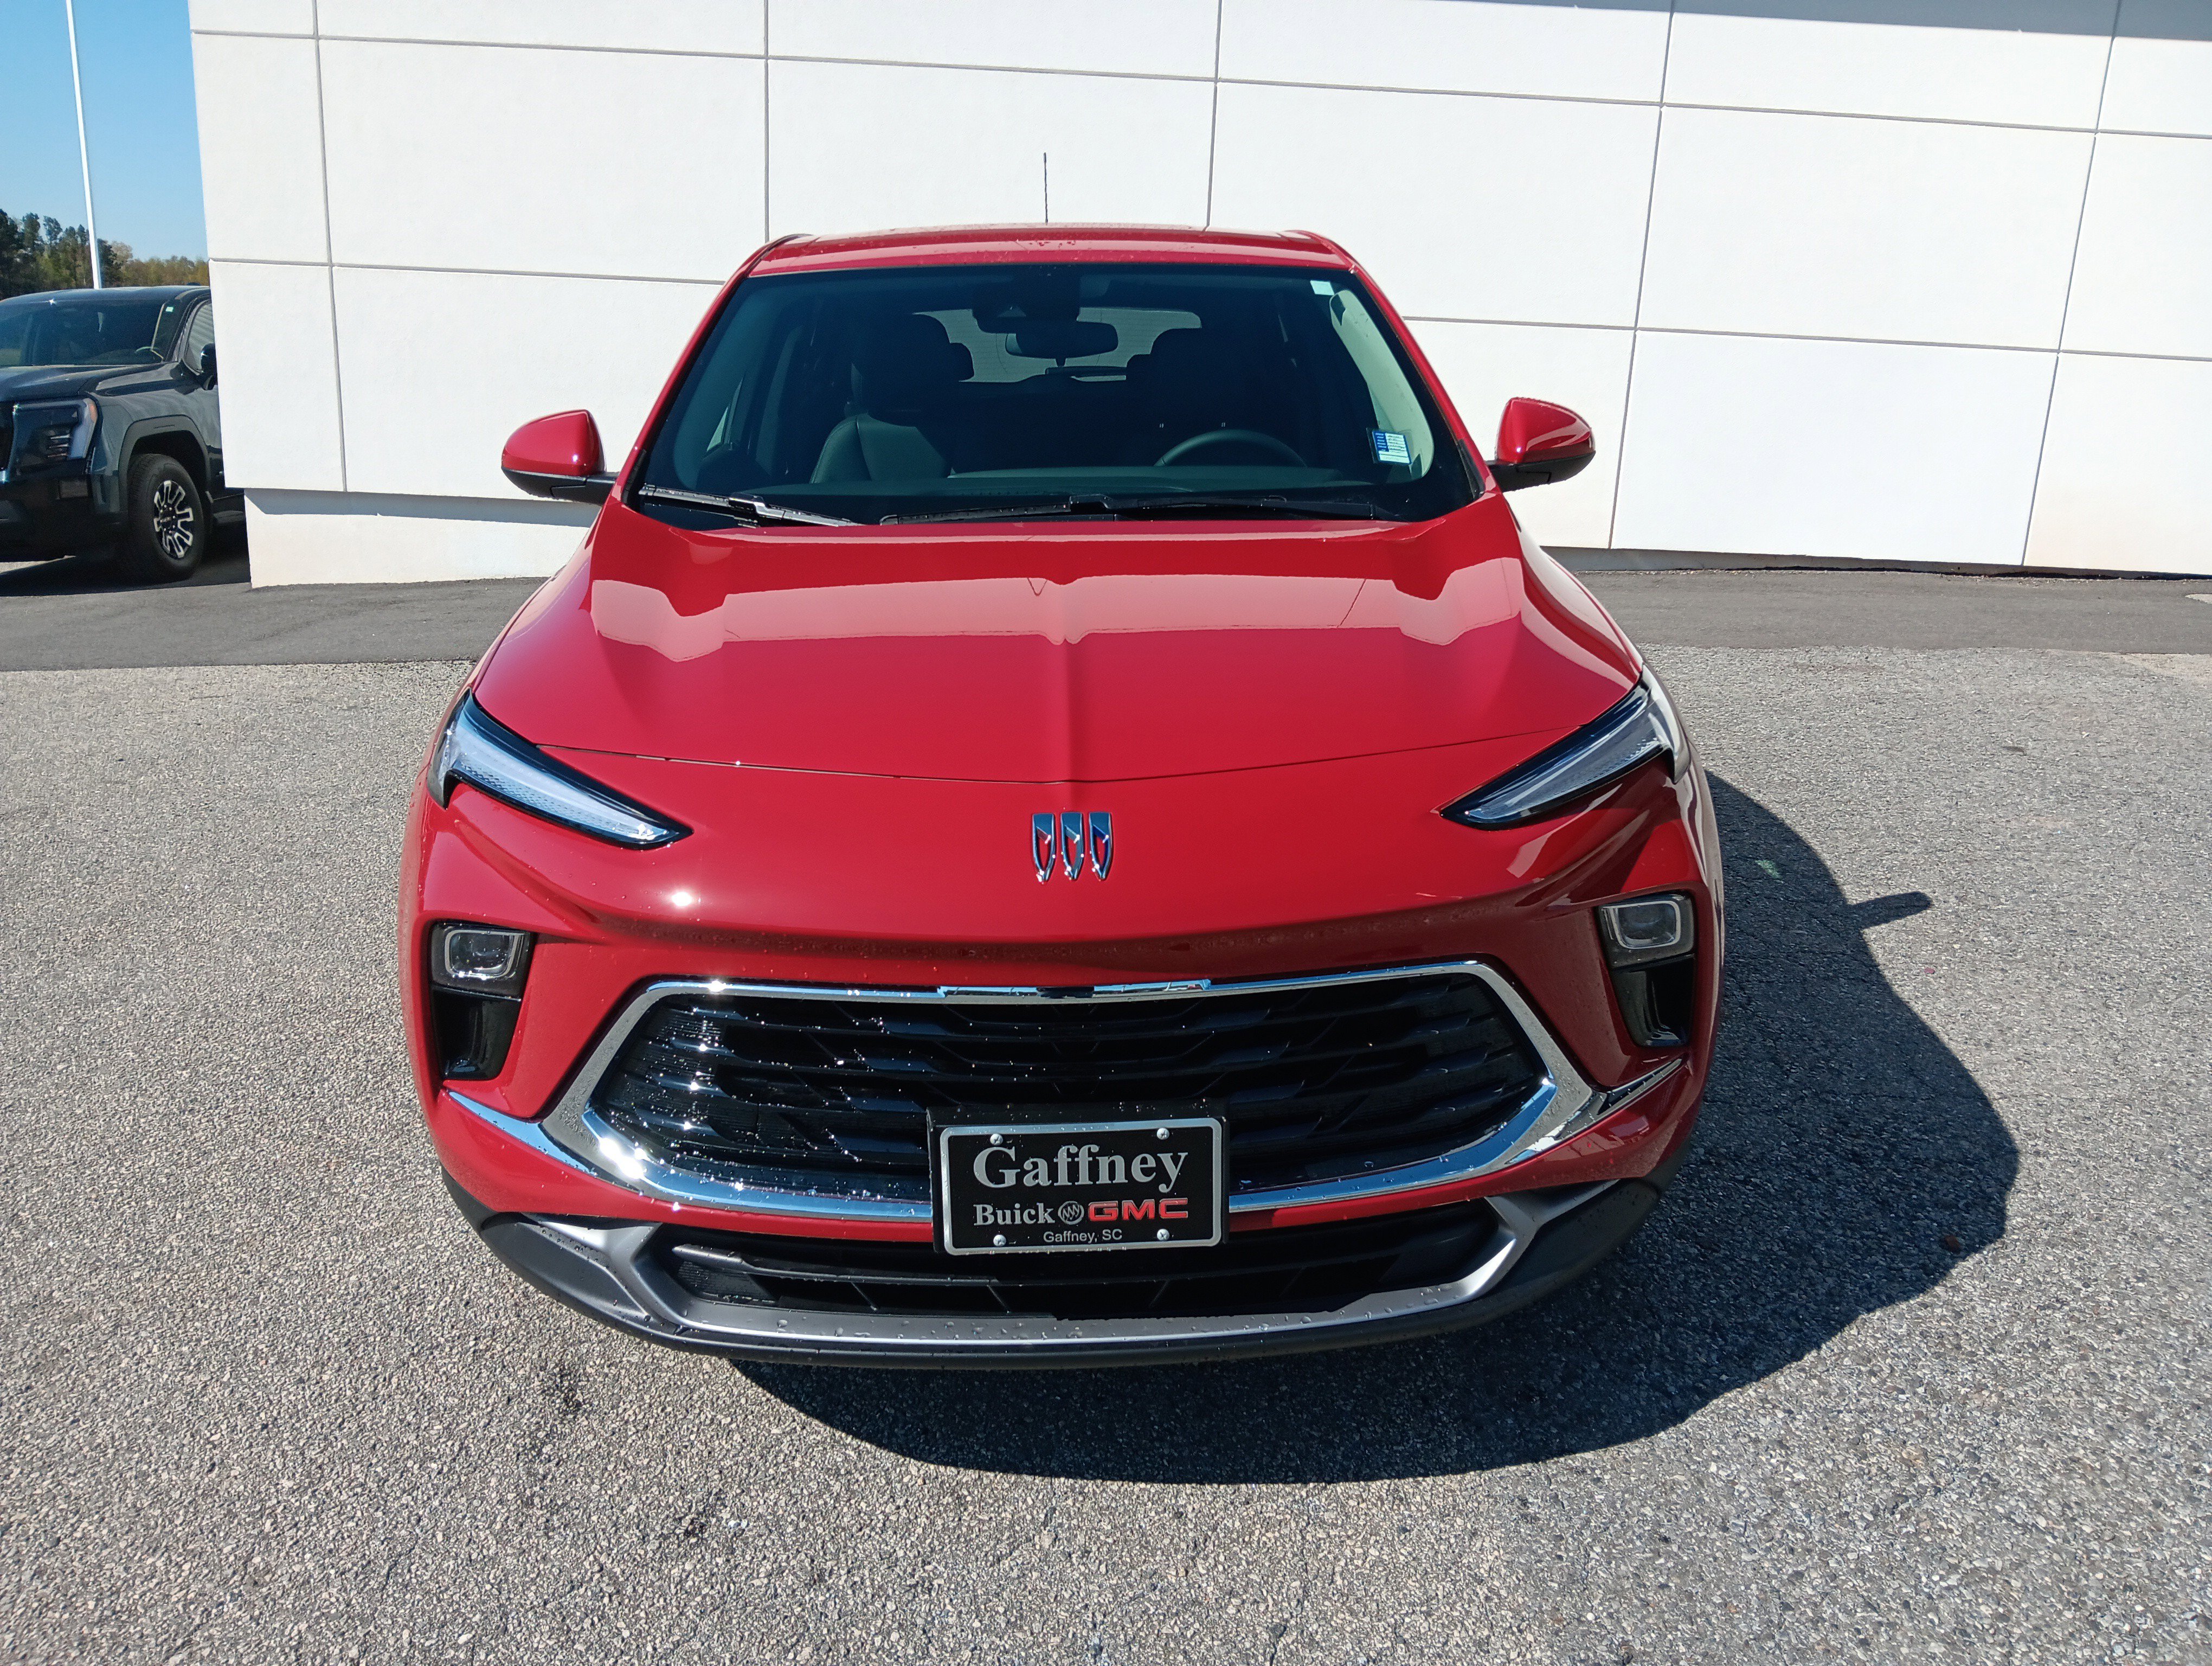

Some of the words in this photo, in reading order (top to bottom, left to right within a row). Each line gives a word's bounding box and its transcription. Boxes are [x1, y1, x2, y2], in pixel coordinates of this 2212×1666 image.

[973, 1144, 1188, 1193] Gaffney
[973, 1202, 1055, 1226] Buick
[1088, 1197, 1188, 1222] GMC
[1043, 1229, 1098, 1243] Gaffney,
[1102, 1228, 1123, 1240] SC
